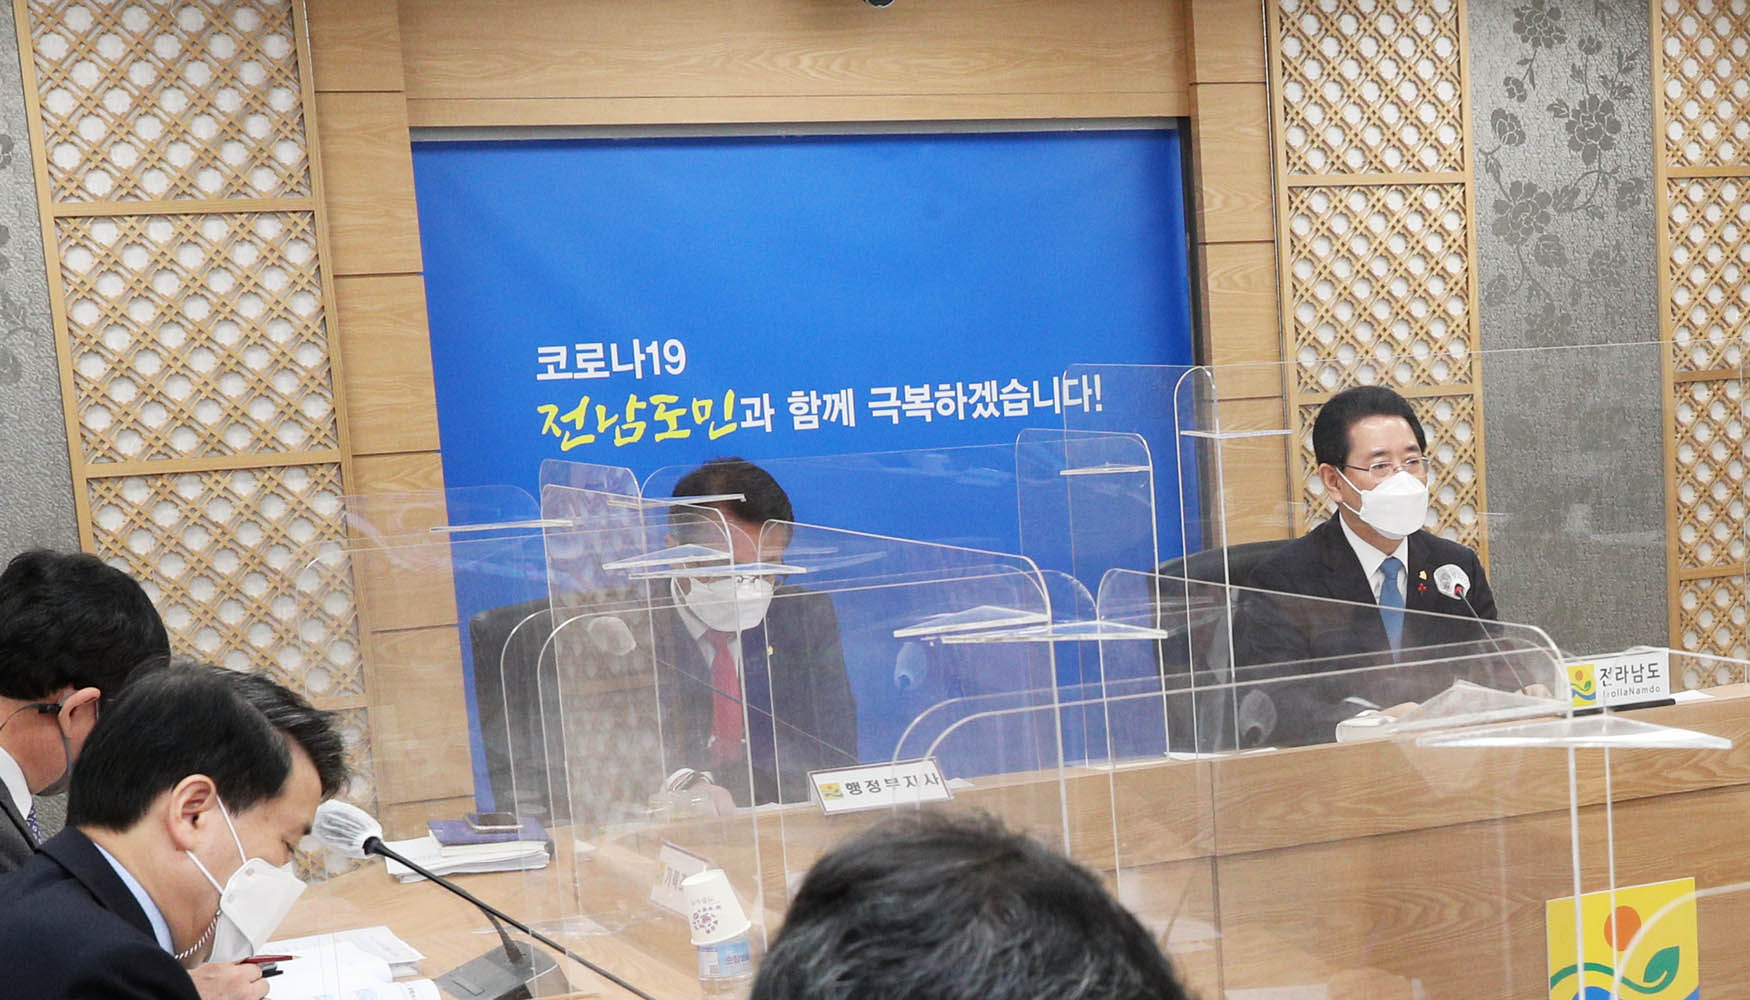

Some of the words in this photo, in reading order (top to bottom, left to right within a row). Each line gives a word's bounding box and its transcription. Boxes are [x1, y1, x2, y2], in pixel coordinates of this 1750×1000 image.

[536, 338, 687, 381] 코로나19
[538, 388, 776, 452] 전남도민과
[786, 388, 857, 430] 함께
[867, 374, 1103, 423] 극복하겠습니다!
[1599, 662, 1660, 687] 전라남도
[1602, 685, 1661, 698] ollaNamdo
[844, 772, 940, 796] 행정부지사
